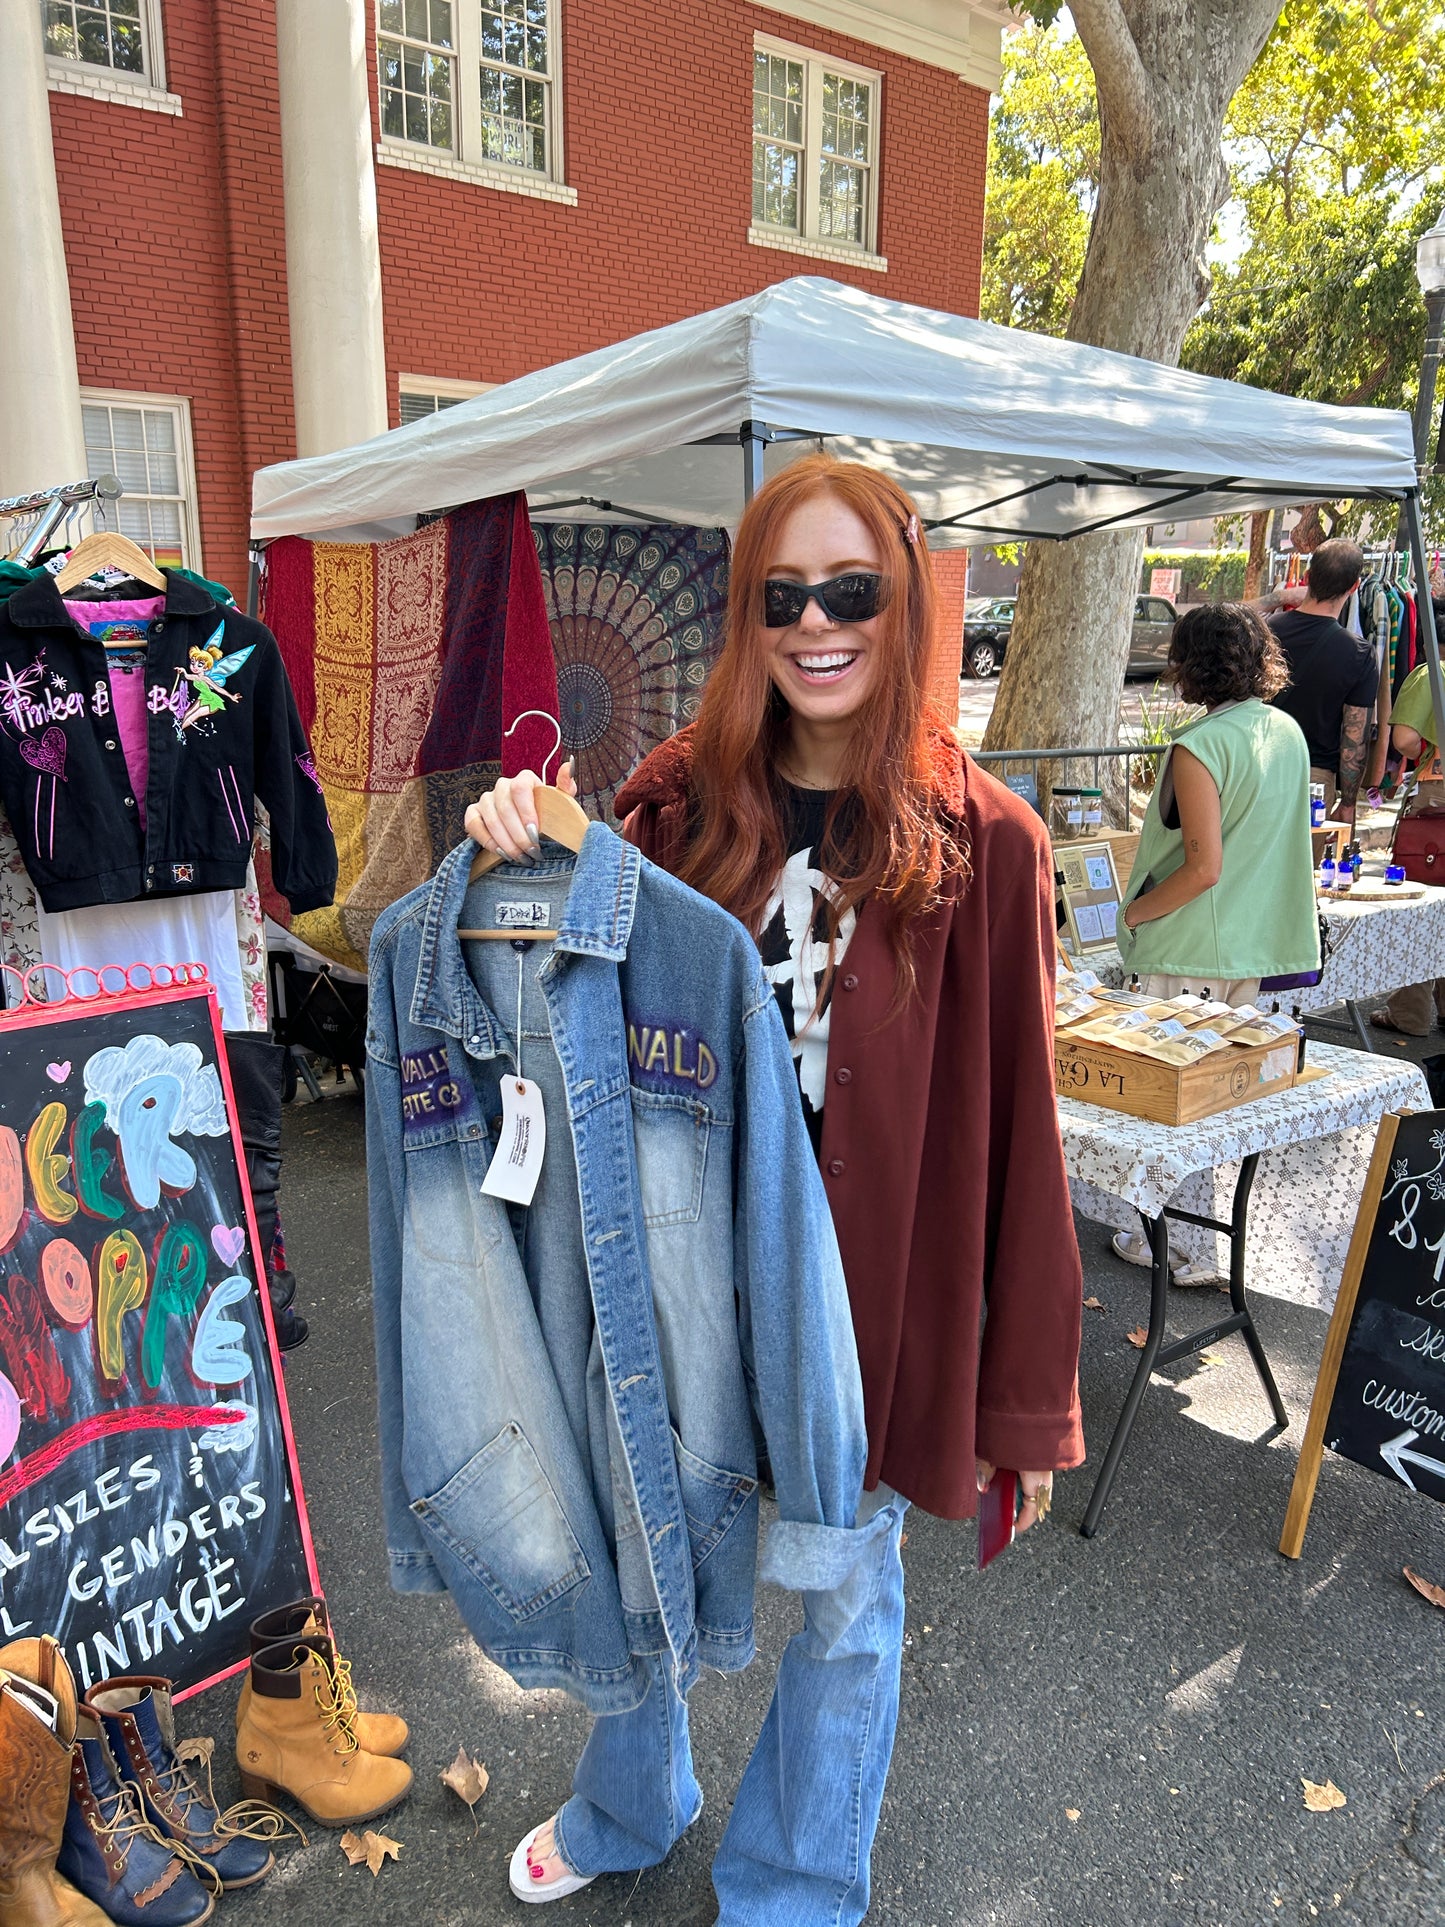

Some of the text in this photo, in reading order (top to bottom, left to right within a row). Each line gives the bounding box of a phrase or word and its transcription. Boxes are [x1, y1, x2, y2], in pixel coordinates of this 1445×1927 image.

[4, 687, 84, 733] Tinker
[629, 1024, 716, 1088] NALD
[1055, 1058, 1125, 1096] LA GA
[1056, 1078, 1073, 1089] CH
[0, 1074, 197, 1250] EER
[25, 1454, 161, 1546] SIZES
[68, 1481, 266, 1601] GENDERS
[60, 1557, 246, 1690] INTAGE
